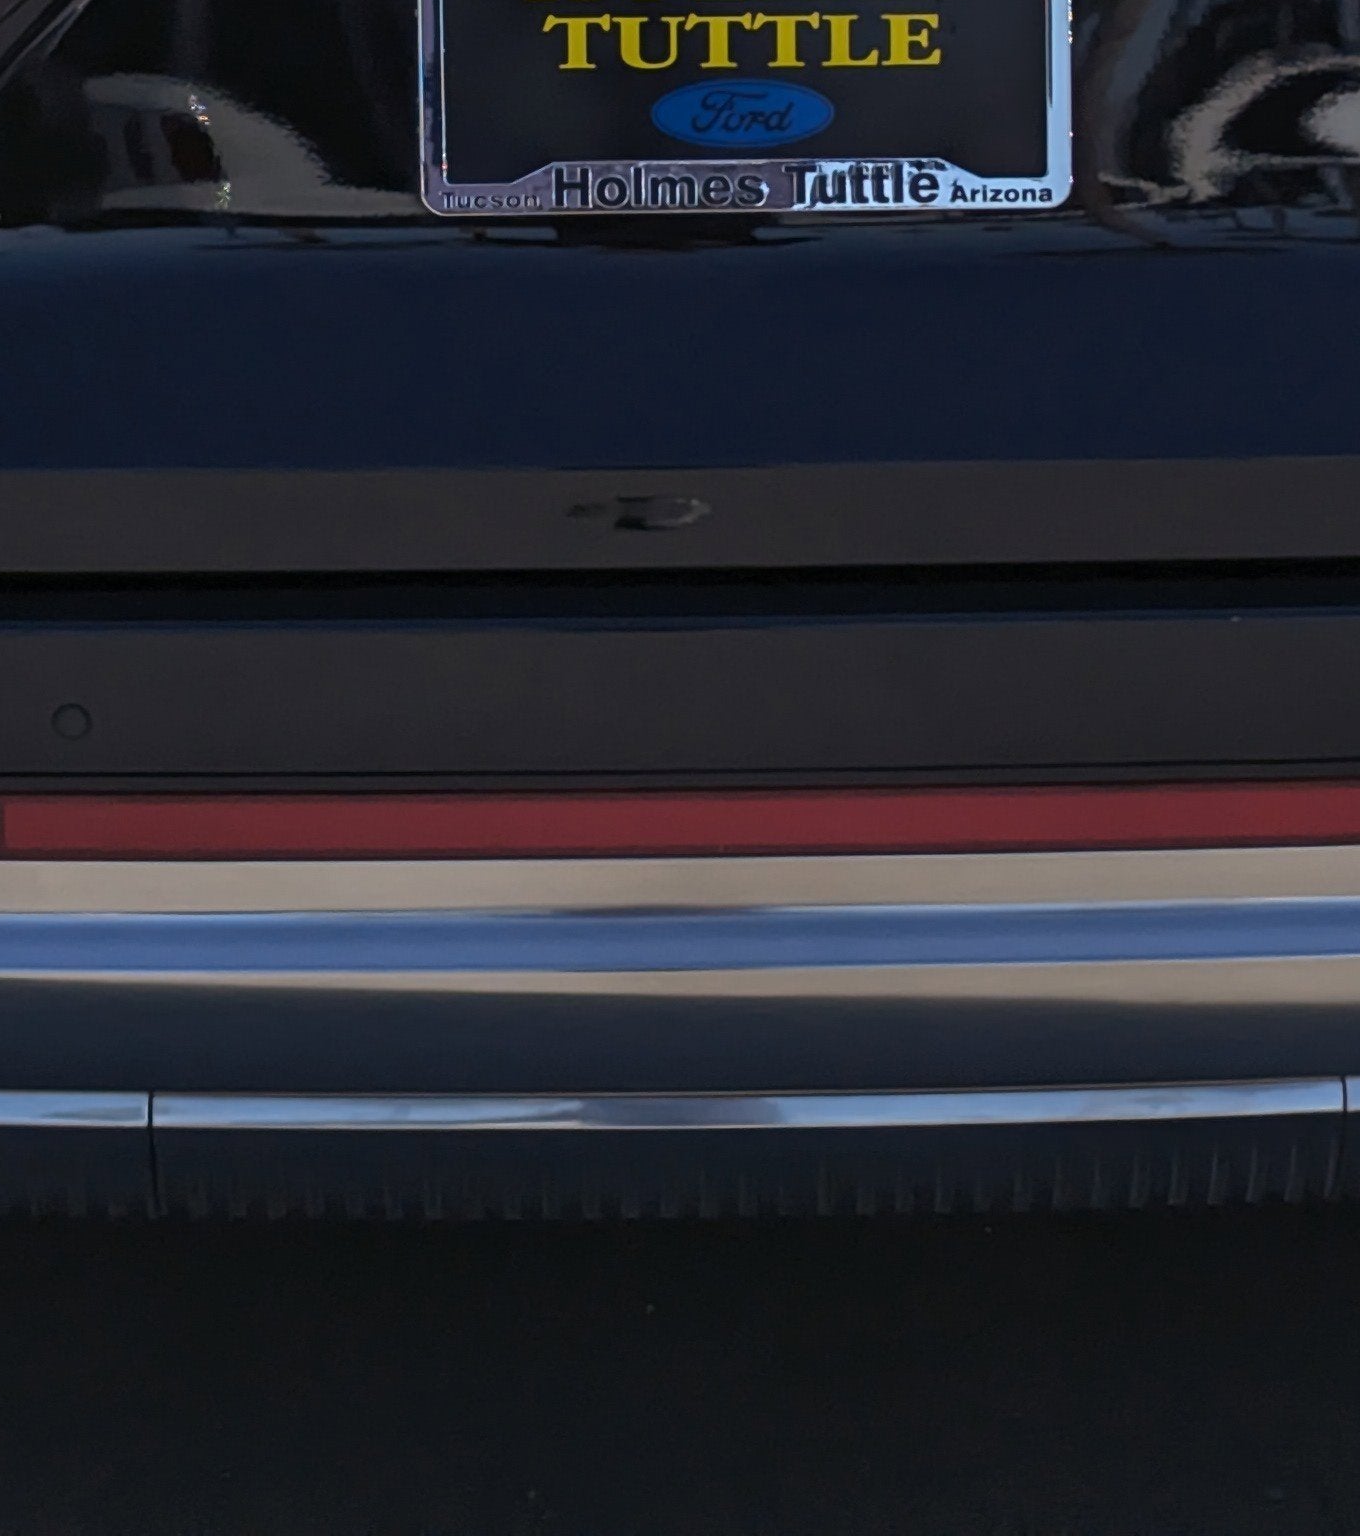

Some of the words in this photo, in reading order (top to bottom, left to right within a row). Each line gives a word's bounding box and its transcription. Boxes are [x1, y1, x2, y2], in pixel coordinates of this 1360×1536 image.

[543, 13, 941, 69] TUTTLE
[691, 90, 794, 133] Ford
[442, 192, 540, 210] Tucson
[551, 165, 770, 208] Holmes
[783, 163, 940, 206] Tuttle
[951, 183, 1053, 203] Arizona
